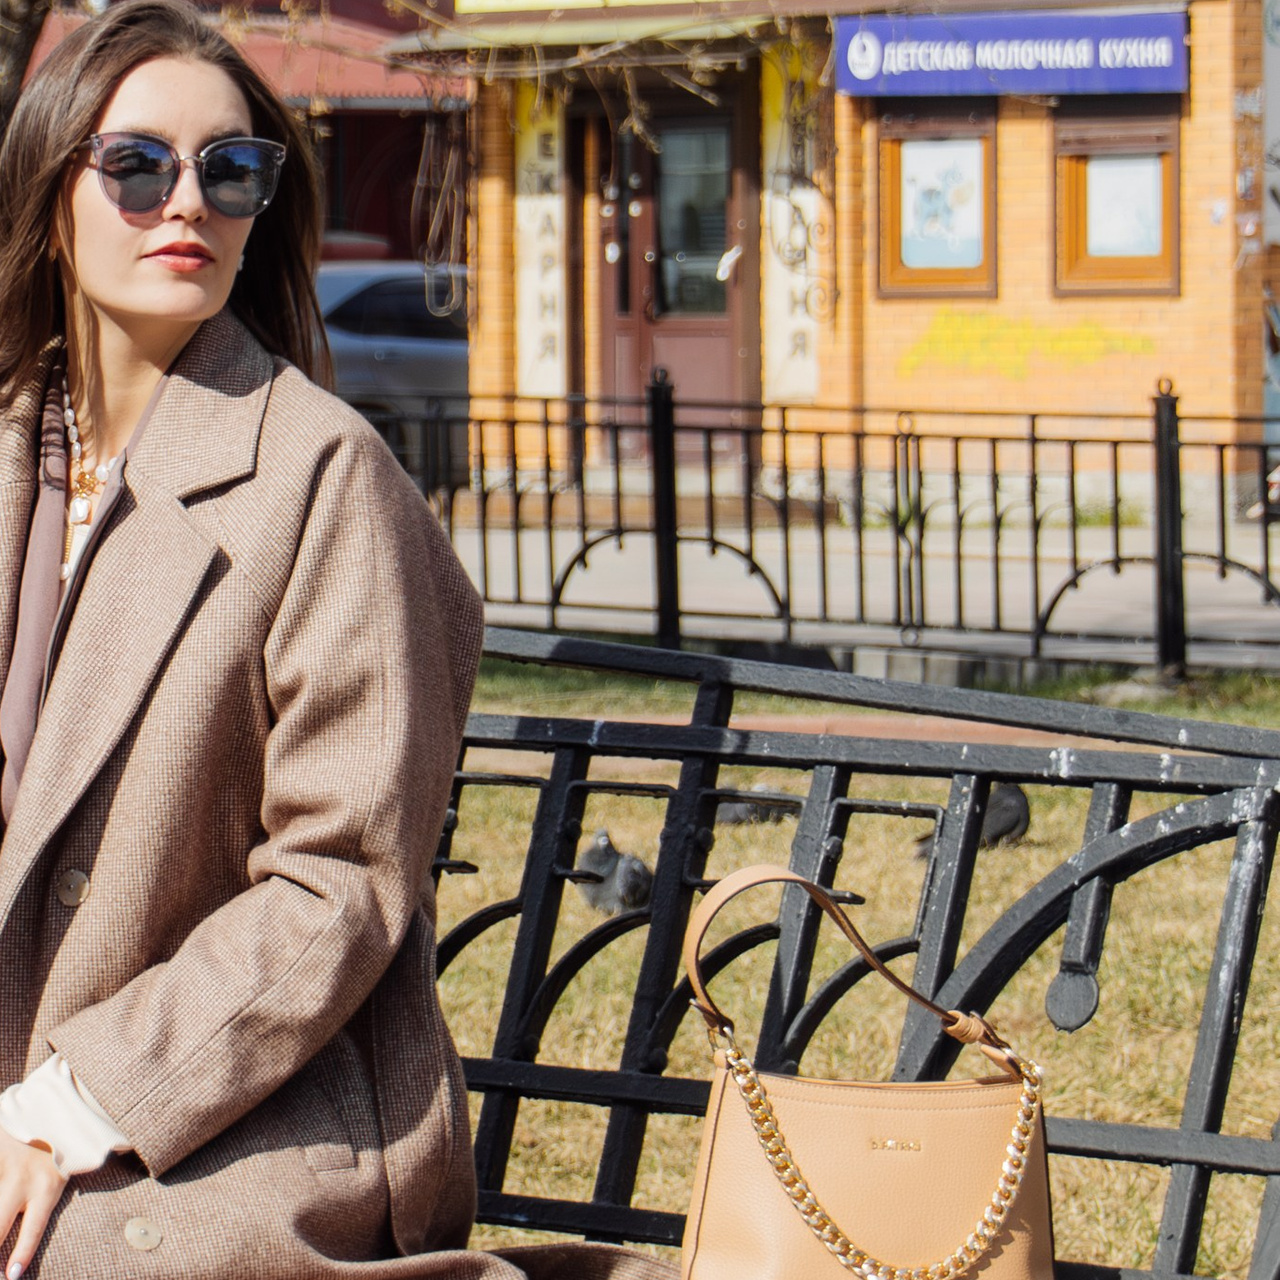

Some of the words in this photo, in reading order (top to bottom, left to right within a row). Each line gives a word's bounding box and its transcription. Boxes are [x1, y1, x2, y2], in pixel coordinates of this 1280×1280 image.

[882, 40, 972, 75] ДЕТСКАЯ
[976, 38, 1094, 70] МОЛОЧНАЯ
[1098, 36, 1172, 68] КУХНЯ
